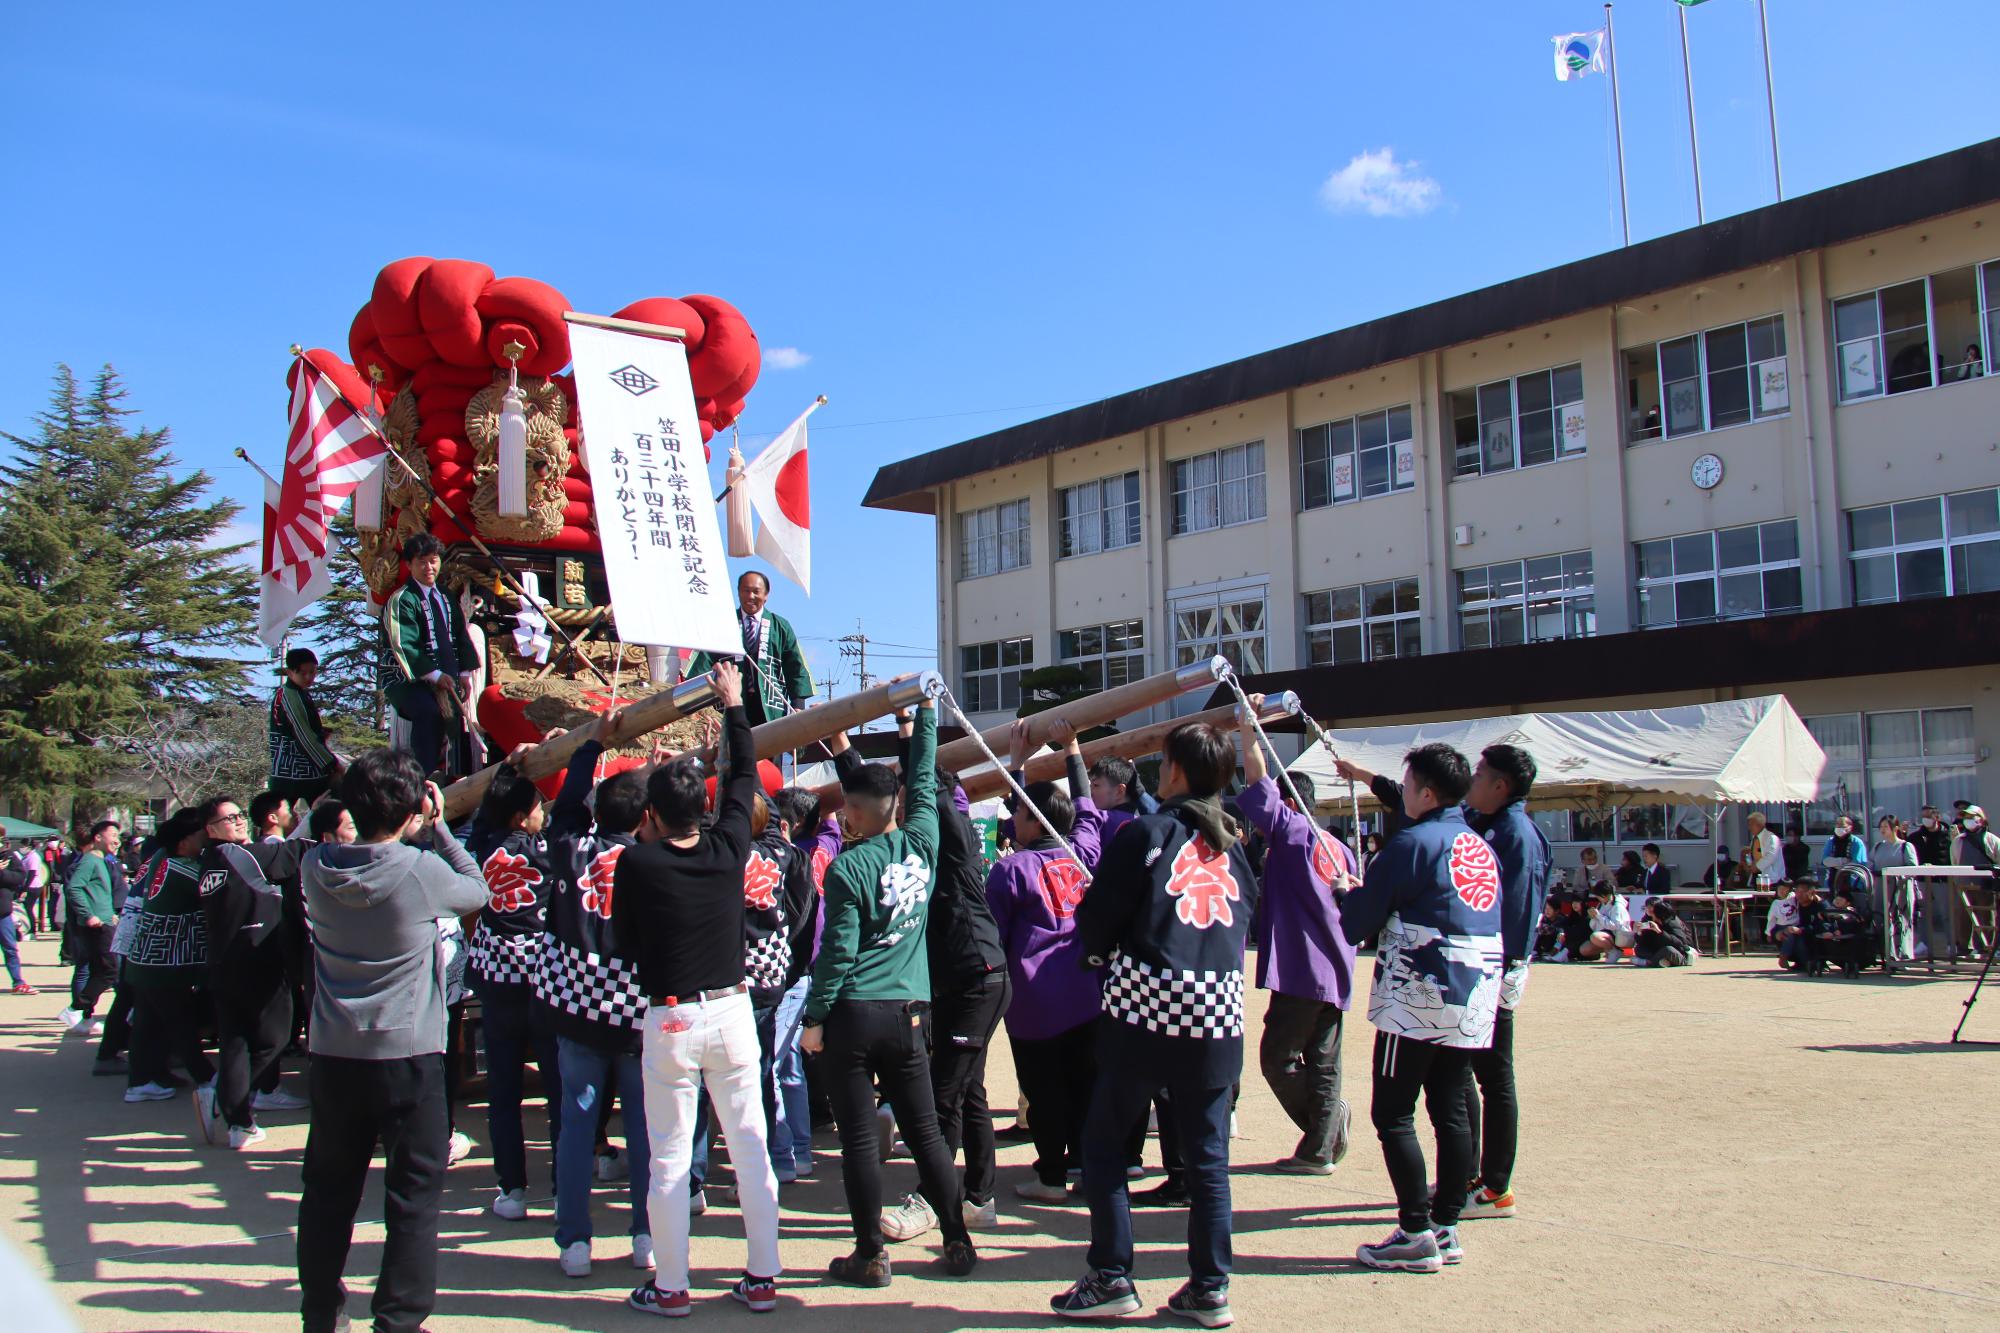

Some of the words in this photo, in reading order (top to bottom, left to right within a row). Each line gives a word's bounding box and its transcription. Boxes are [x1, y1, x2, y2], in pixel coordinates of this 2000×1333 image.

[610, 446, 639, 561] ありがとう！
[632, 433, 672, 549] 百三十四年間
[658, 416, 709, 595] 笠田小学校閉校記念
[482, 847, 544, 913] 祭
[1164, 830, 1240, 929] 祭
